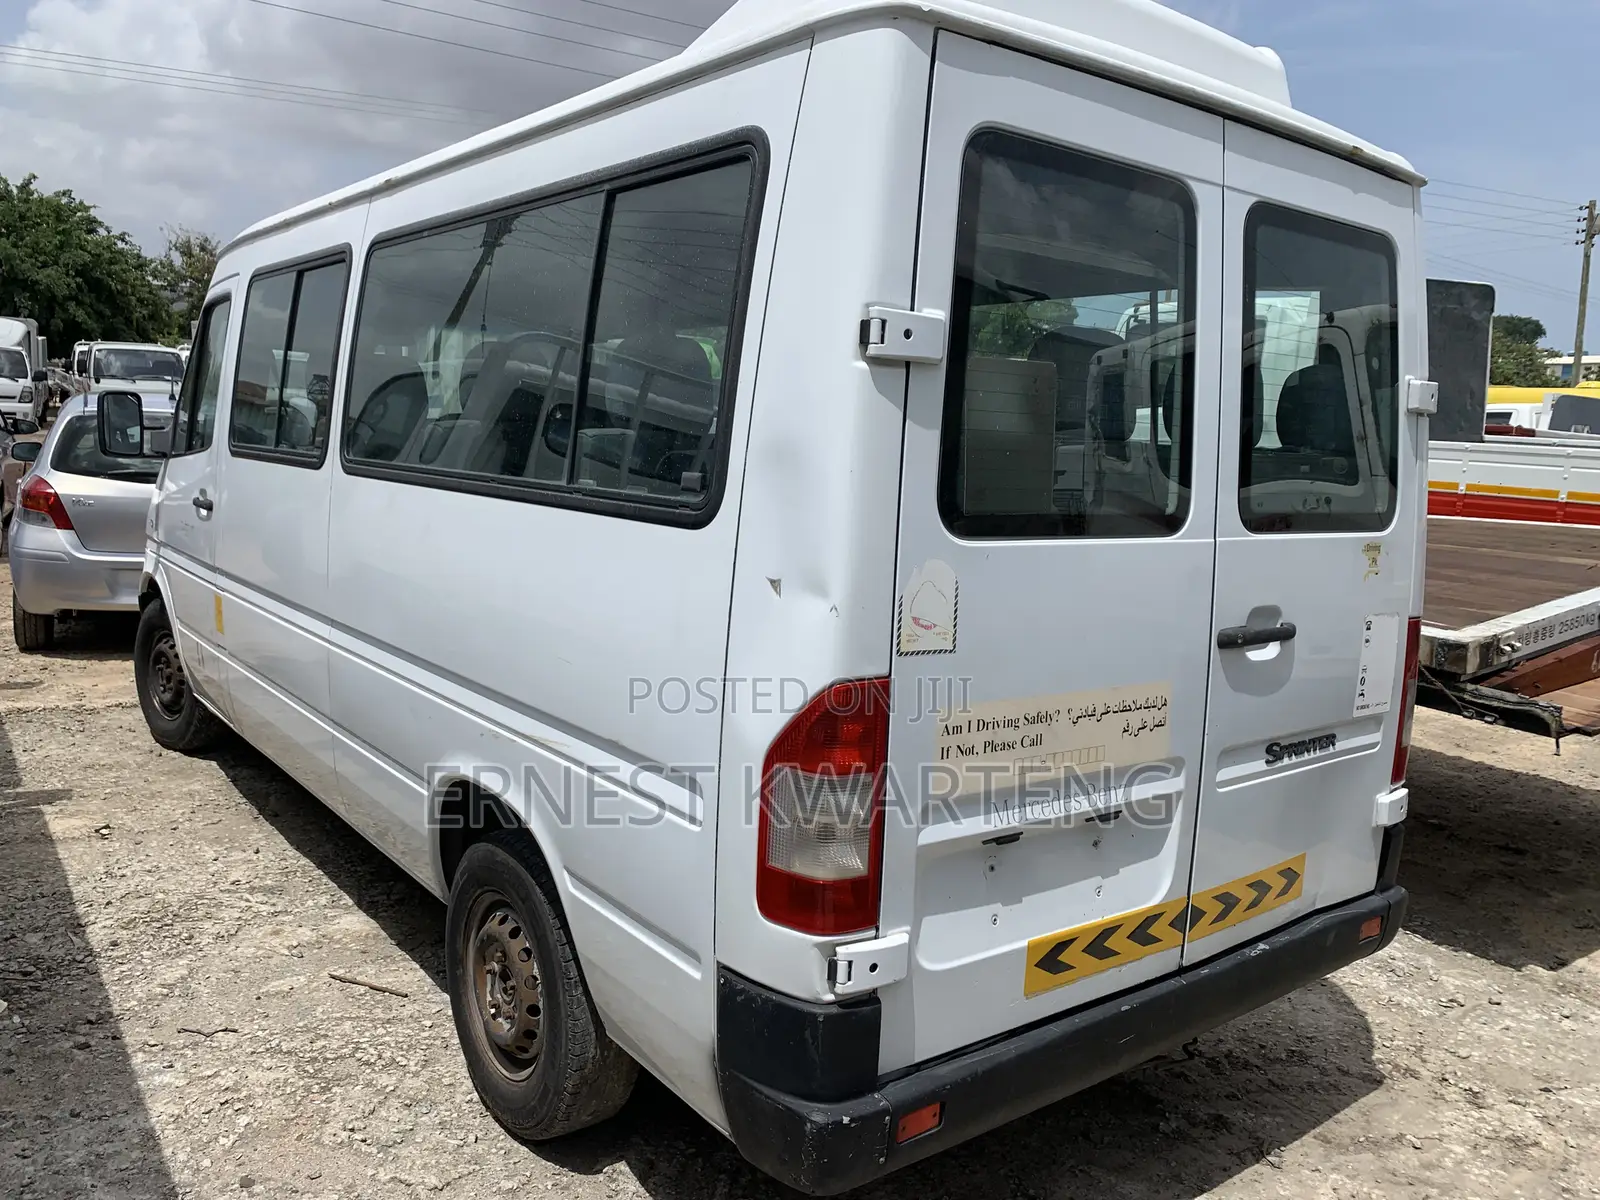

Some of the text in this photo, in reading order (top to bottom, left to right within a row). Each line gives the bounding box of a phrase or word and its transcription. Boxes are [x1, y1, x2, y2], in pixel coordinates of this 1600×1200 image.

[1096, 702, 1112, 722] على
[1112, 699, 1143, 714] ملاحظات
[941, 709, 1061, 737] Am I Driving Safely?
[1121, 719, 1134, 740] رقم
[1133, 717, 1149, 737] على
[940, 733, 1043, 760] If Not, Please Call
